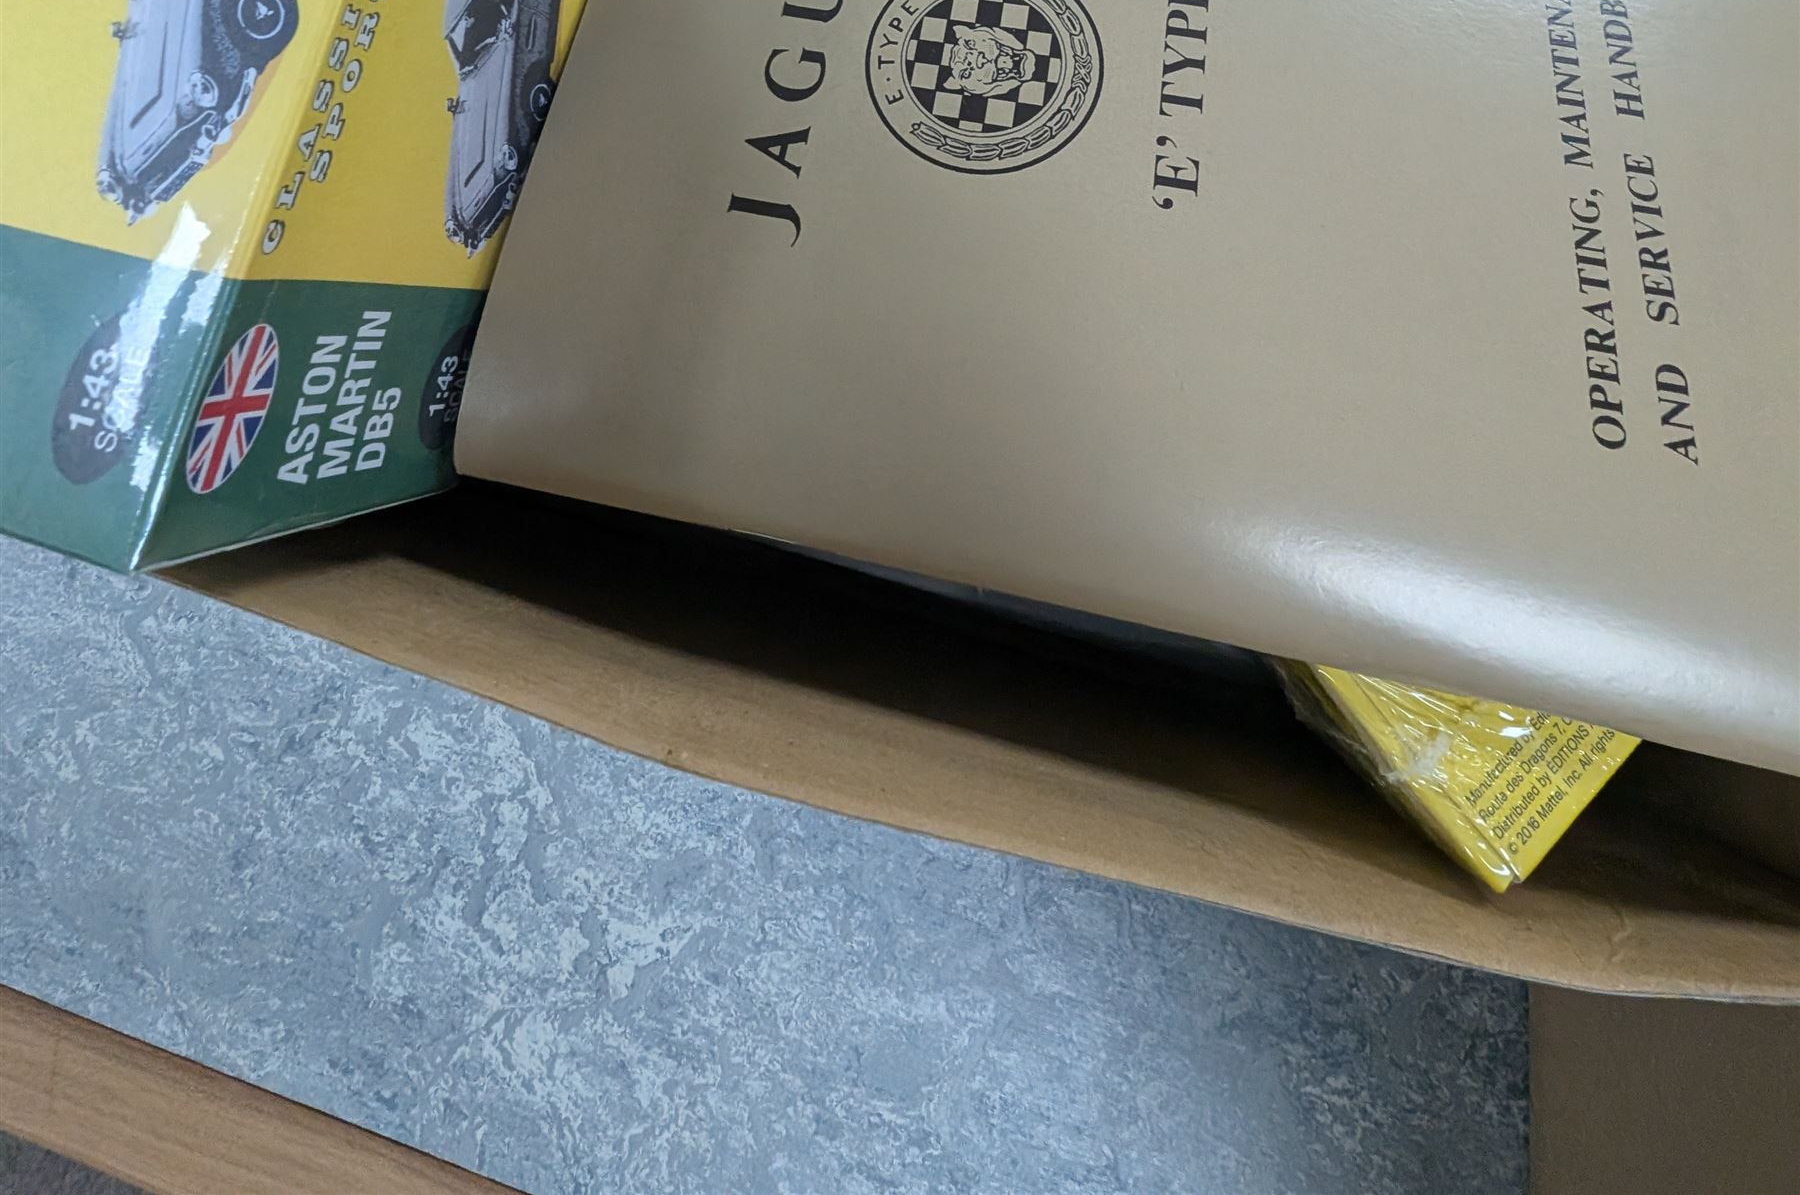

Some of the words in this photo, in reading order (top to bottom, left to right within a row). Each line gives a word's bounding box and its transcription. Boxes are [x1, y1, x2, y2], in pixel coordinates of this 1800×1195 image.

[1622, 151, 1681, 327] SERVICE
[1568, 185, 1628, 450] OPERATING,
[68, 348, 119, 431] 1:43
[276, 334, 348, 485] ASTON
[317, 310, 392, 480] MARTIN
[355, 387, 402, 472] DB5
[429, 355, 459, 417] 1:43
[1653, 362, 1700, 466] AND
[1478, 792, 1508, 823] Route
[1505, 773, 1525, 794] des
[1520, 734, 1558, 775] Dragons
[1492, 786, 1541, 840] Distributed
[1535, 772, 1553, 789] by
[1516, 816, 1541, 846] 2016
[1535, 786, 1569, 822] Mattel,
[1562, 769, 1583, 789] Inc.
[1578, 755, 1593, 772] All
[1590, 729, 1616, 756] rights
